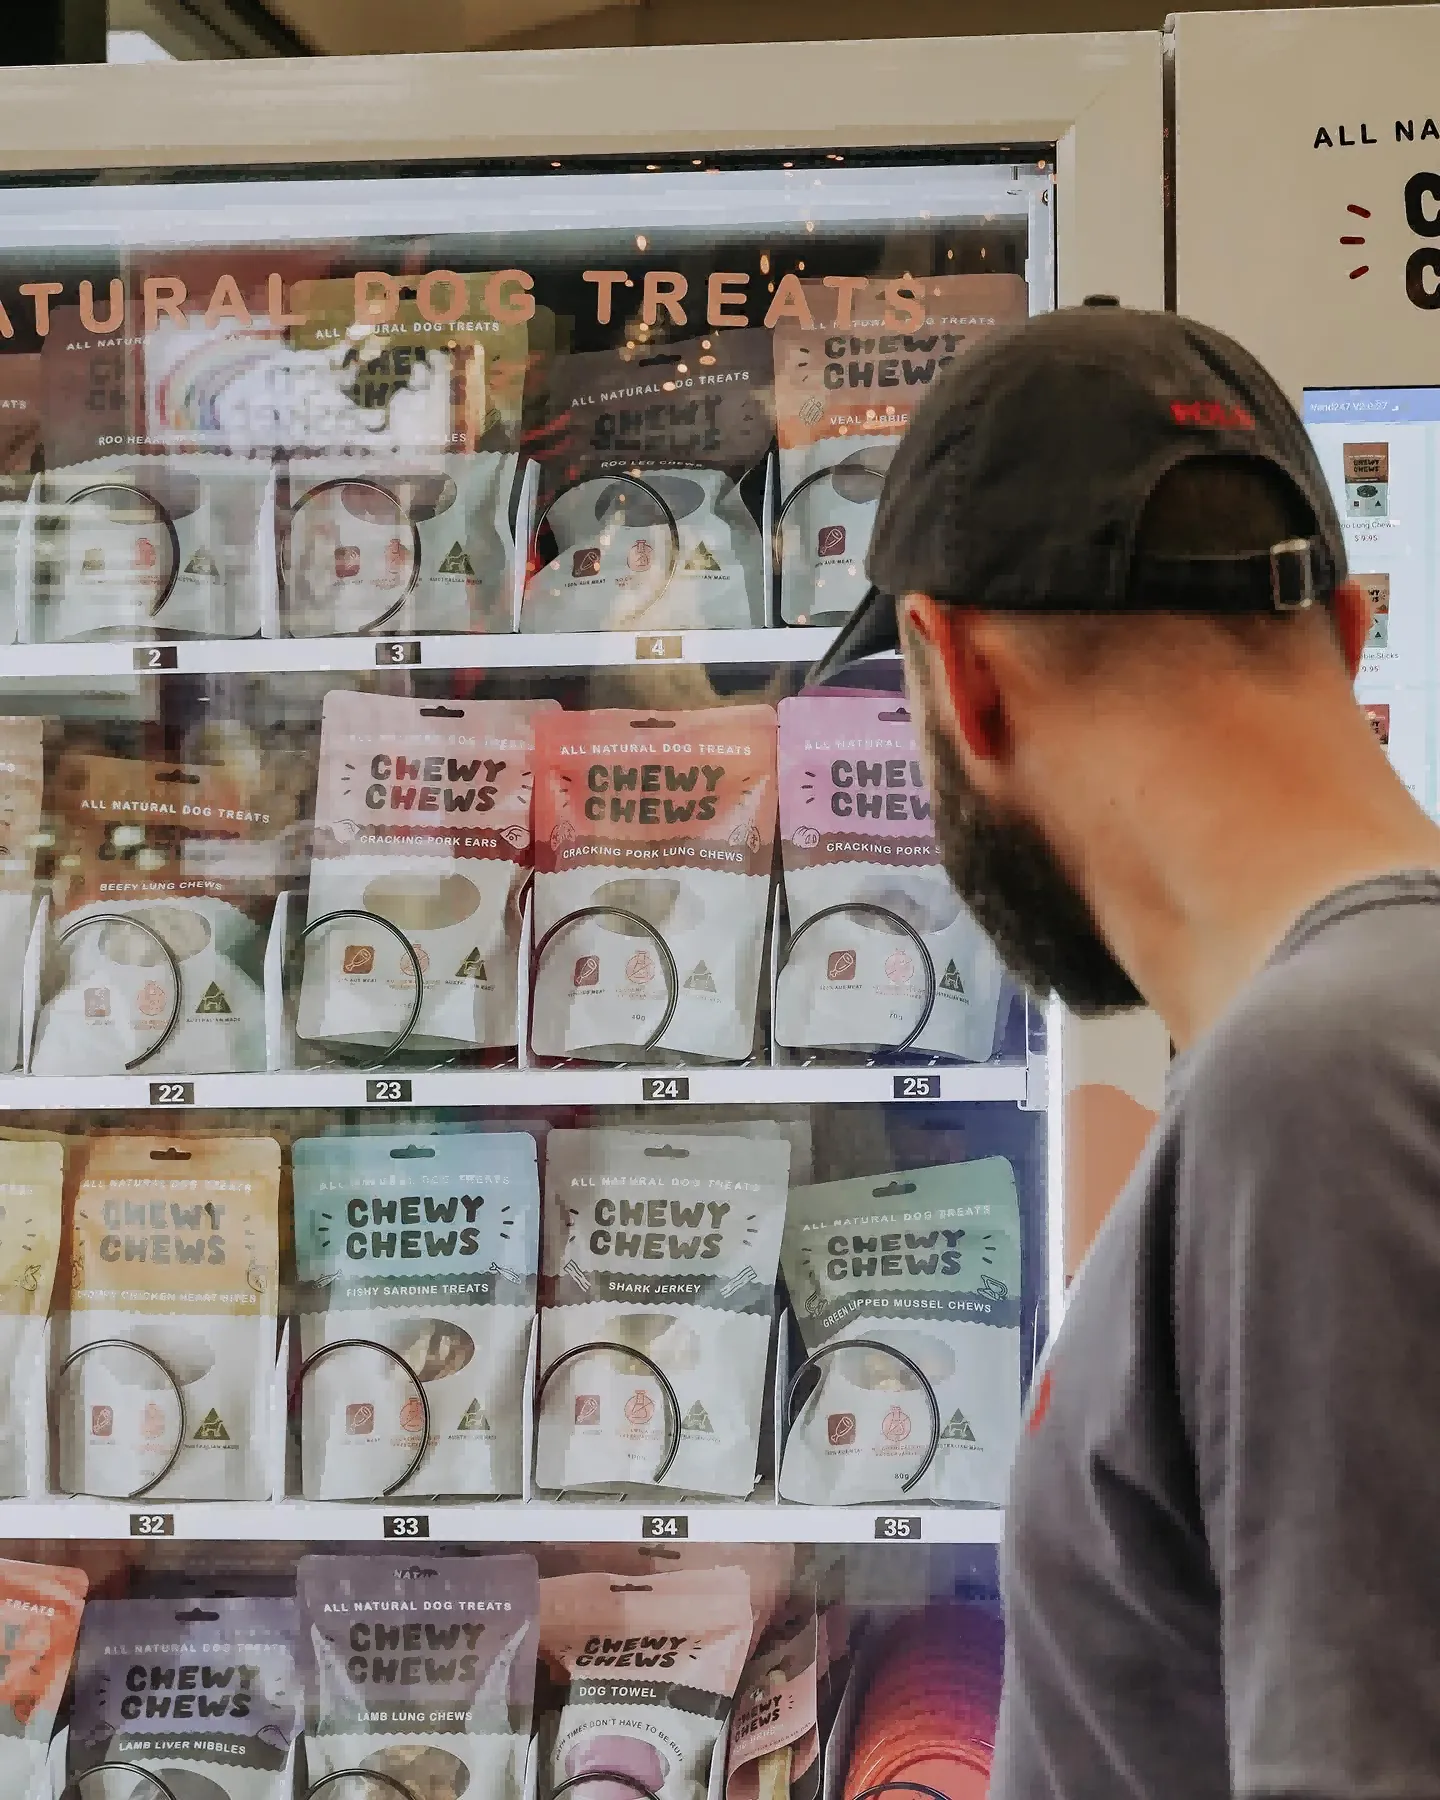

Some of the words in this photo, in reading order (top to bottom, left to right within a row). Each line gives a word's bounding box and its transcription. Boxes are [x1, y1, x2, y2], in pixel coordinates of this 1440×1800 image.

[1313, 123, 1377, 149] ALL
[1395, 119, 1440, 142] NA
[1404, 171, 1440, 238] C
[1405, 247, 1440, 310] C
[353, 269, 536, 328] DOG
[583, 269, 927, 334] TREATS
[315, 327, 341, 341] ALL
[413, 321, 442, 333] DOG
[449, 321, 500, 333] TREATS
[940, 316, 996, 327] TREATS
[66, 342, 91, 352] ALL
[571, 396, 595, 408] ALL
[600, 383, 661, 402] NATURAL
[664, 378, 694, 392] OG
[699, 371, 750, 386] TREATS
[830, 415, 862, 426] VEAL
[98, 434, 123, 446] ROO
[601, 460, 627, 468] ROO
[391, 644, 405, 663] 3
[651, 638, 666, 657] 4
[147, 649, 161, 667] 2
[560, 745, 586, 756] ALL
[592, 743, 656, 754] NATURAL
[663, 743, 692, 753] DOG
[699, 744, 752, 756] TREATS
[371, 753, 506, 783] CHEWY
[588, 764, 726, 793] CHEWY
[365, 783, 498, 813] CHEWS
[81, 799, 106, 810] ALL
[111, 800, 177, 815] NATURAL
[182, 804, 212, 817] DOG
[218, 808, 270, 825] TREATS
[584, 796, 721, 825] CHEWS
[360, 835, 423, 846] CRACKING
[427, 835, 460, 847] PORK
[465, 837, 498, 849] EARS
[826, 842, 892, 855] CRACKING
[896, 846, 931, 856] PORK
[563, 845, 621, 860] CRACKING
[625, 849, 660, 859] PORK
[663, 846, 695, 857] LUNG
[699, 849, 744, 862] CHEWS
[99, 882, 138, 892] BEEFY
[142, 882, 176, 890] LUNG
[179, 880, 222, 891] CHEWS
[158, 1083, 186, 1103] 22
[375, 1081, 402, 1100] 23
[652, 1079, 679, 1099] 24
[903, 1077, 931, 1096] 25
[571, 1177, 596, 1187] ALL
[103, 1200, 226, 1230] CHEWY
[347, 1194, 485, 1228] CHEWY
[594, 1198, 731, 1229] CHEWY
[802, 1221, 828, 1232] ALL
[833, 1214, 898, 1227] NATURAL
[100, 1234, 226, 1265] CHEWS
[345, 1227, 481, 1260] CHEWS
[589, 1229, 724, 1260] CHEWS
[827, 1229, 966, 1257] CHEWY
[826, 1250, 963, 1282] CHEWS
[346, 1286, 379, 1298] FISHY
[383, 1285, 438, 1296] SARDINE
[442, 1283, 489, 1294] TREATS
[608, 1281, 651, 1294] SHARK
[654, 1283, 701, 1294] JERKEY
[822, 1304, 850, 1329] GREEN
[849, 1298, 890, 1312] LIPPED
[893, 1299, 944, 1310] MUSSEL
[947, 1300, 993, 1314] CHEWS
[138, 1515, 165, 1536] 32
[393, 1517, 420, 1537] 33
[651, 1517, 678, 1537] 34
[883, 1517, 911, 1536] 35
[4, 1598, 56, 1617] TREATS
[324, 1603, 349, 1613] ALL
[354, 1601, 418, 1612] NATURAL
[423, 1601, 453, 1611] DOG
[459, 1601, 512, 1611] TREATS
[350, 1623, 486, 1652] CHEWY
[584, 1636, 688, 1655] CHEWY
[347, 1655, 480, 1685] CHEWS
[575, 1651, 678, 1669] CHEWS
[126, 1664, 260, 1692] CHEWY
[579, 1686, 607, 1697] DOG
[611, 1686, 657, 1698] TOWEL
[120, 1693, 252, 1720] CHEWS
[357, 1712, 388, 1722] LAMB
[391, 1712, 425, 1722] LUNG
[429, 1711, 473, 1721] CHEWS
[566, 1723, 588, 1740] TIMES
[589, 1718, 617, 1728] DON'T
[619, 1719, 643, 1730] HAVE
[645, 1723, 657, 1734] TO
[658, 1731, 670, 1743] BE
[119, 1741, 151, 1752] LAMB
[155, 1741, 190, 1750] LIVER
[194, 1741, 246, 1755] NIBBLES
